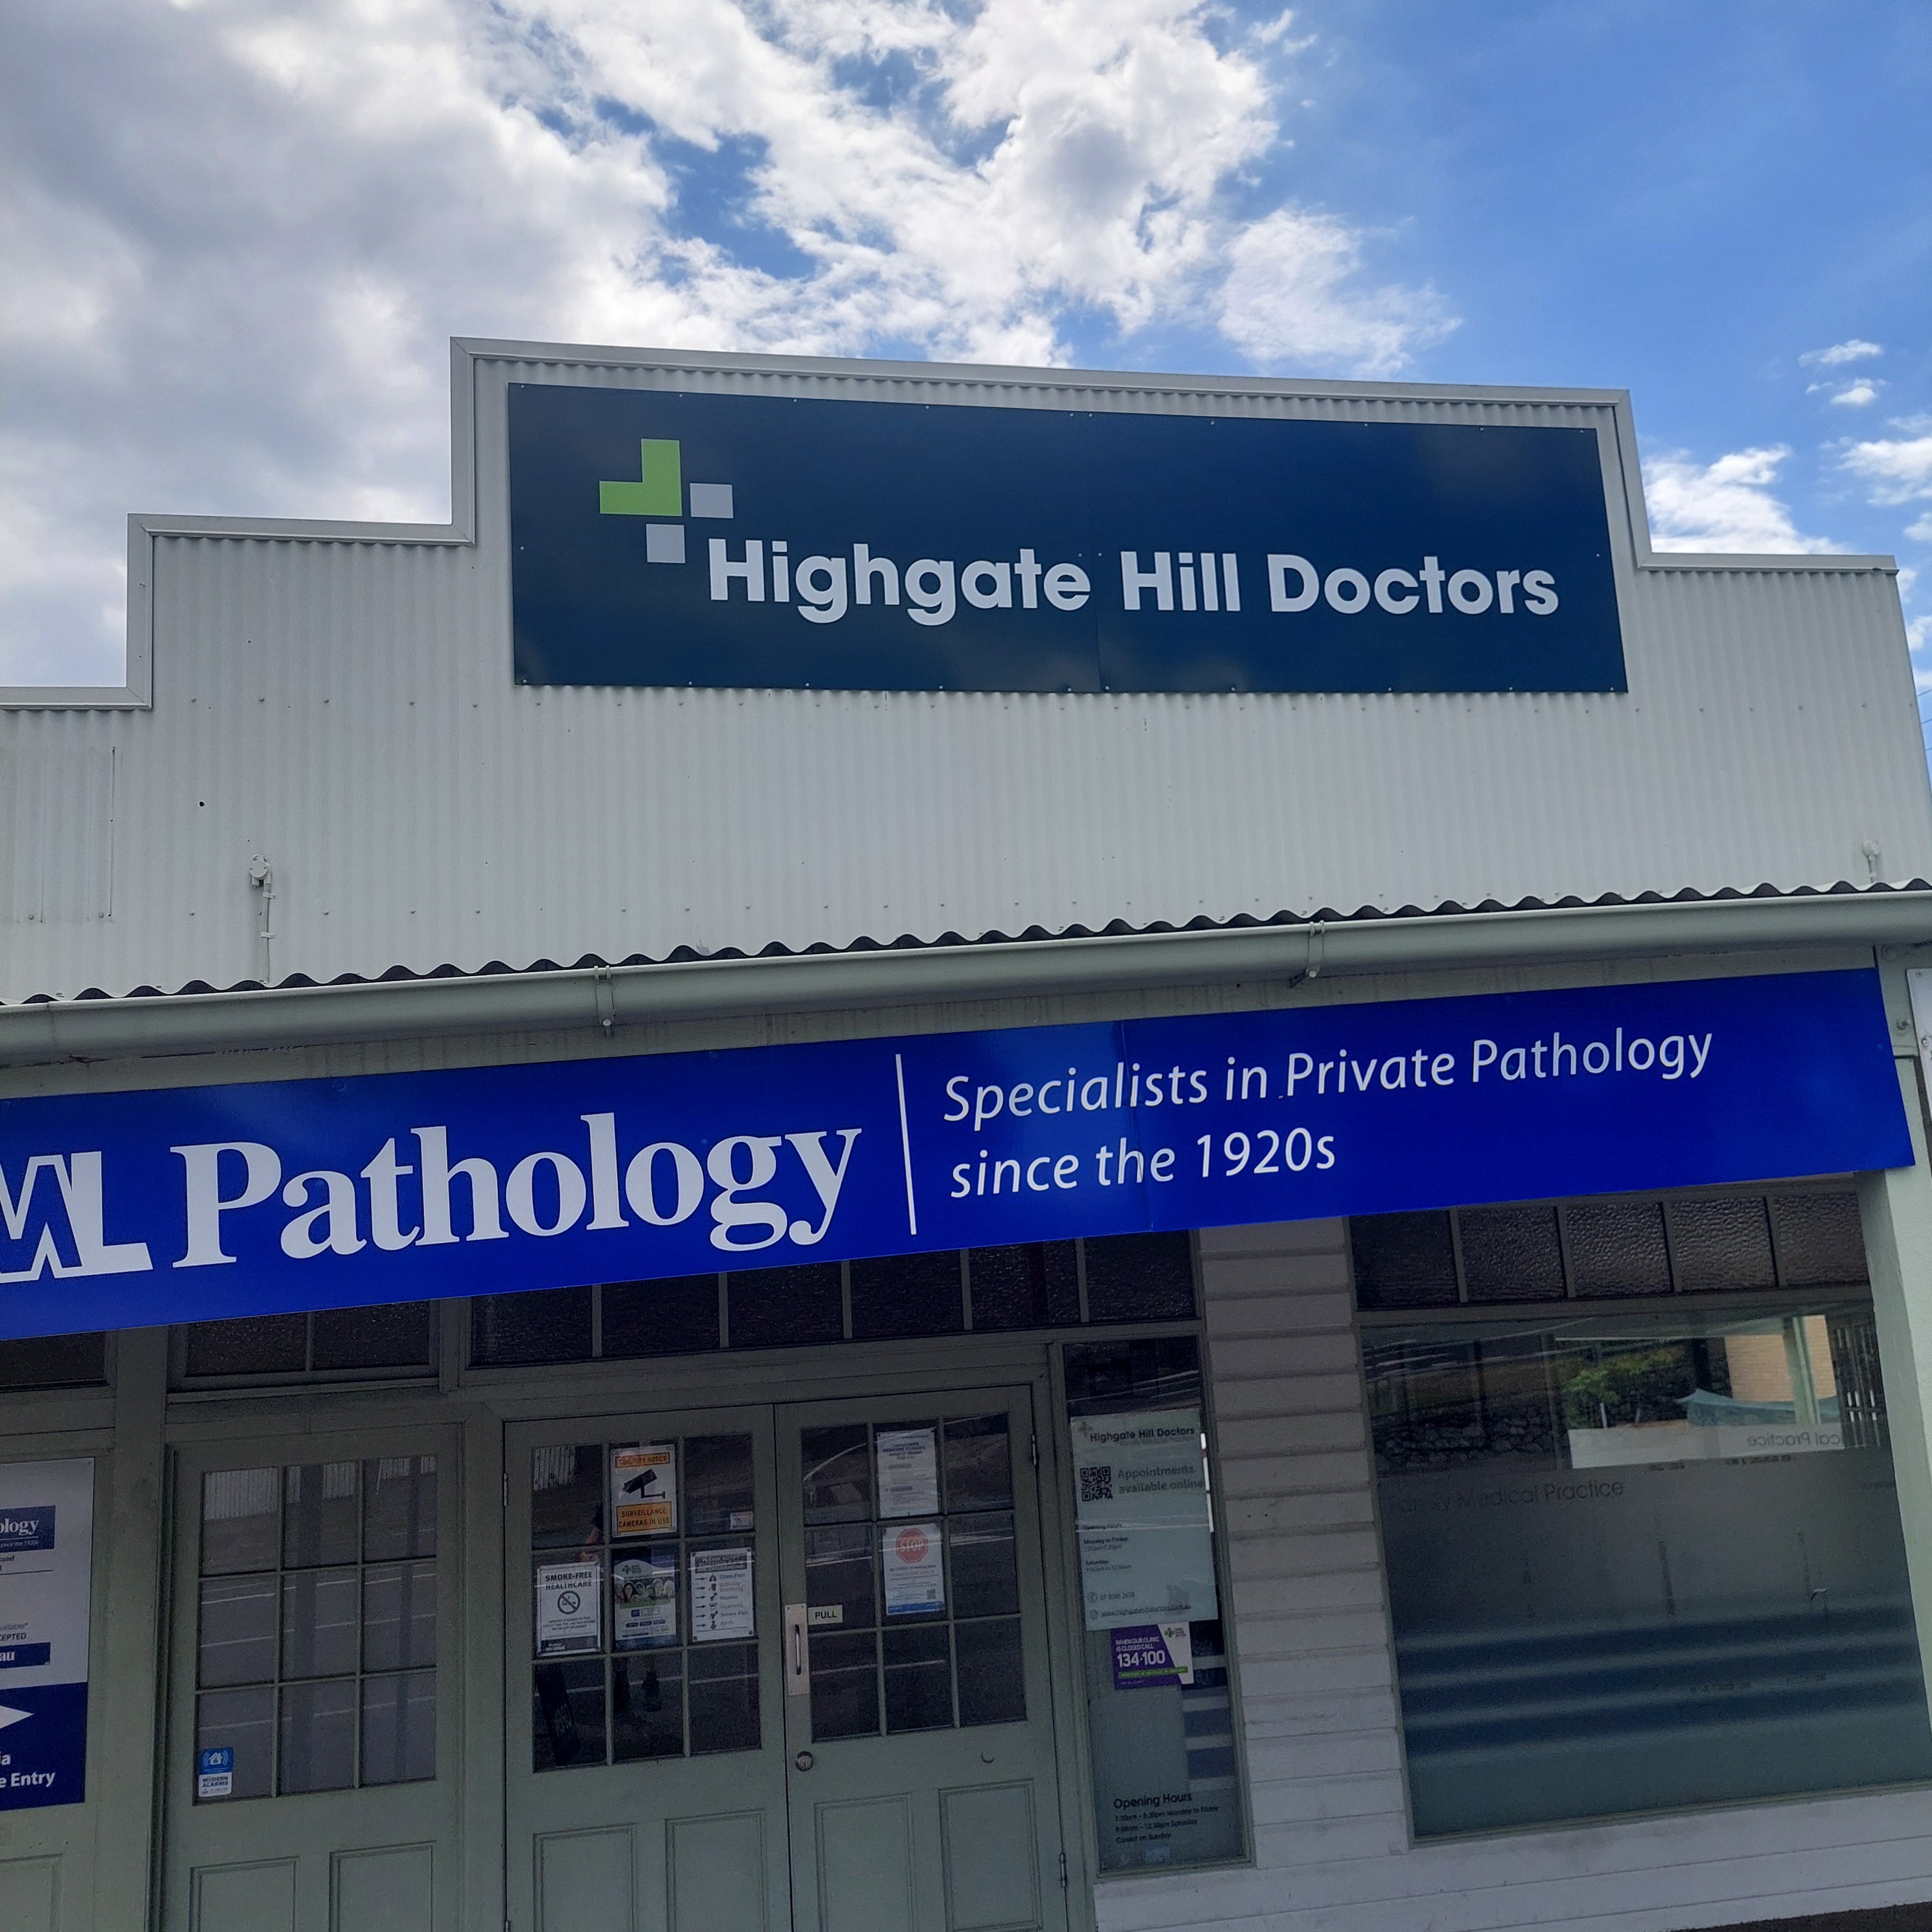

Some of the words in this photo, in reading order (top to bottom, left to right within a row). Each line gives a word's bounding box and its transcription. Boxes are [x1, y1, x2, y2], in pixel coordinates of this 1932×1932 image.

[708, 538, 1091, 626] Highgate
[1120, 551, 1241, 612] Hill
[1266, 554, 1559, 615] Doctors
[944, 1061, 1208, 1132] Specialists
[1225, 1056, 1268, 1101] in
[1287, 1048, 1455, 1097] Private
[1472, 1027, 1713, 1084] Pathology
[950, 1150, 1080, 1199] since
[1095, 1137, 1176, 1186] the
[1196, 1127, 1336, 1178] 1920s
[170, 1112, 862, 1269] Pathology
[1090, 1431, 1136, 1443] Highgate
[1138, 1428, 1155, 1438] Hill
[1156, 1426, 1196, 1437] Doctors
[1117, 1465, 1194, 1481] Appointments
[1118, 1480, 1168, 1494] available
[1169, 1478, 1205, 1490] online
[1544, 1477, 1625, 1503] Practice
[621, 1507, 667, 1518] SURVEILLANCE
[618, 1519, 648, 1528] CAMERAS
[899, 1539, 924, 1552] STOP
[545, 1571, 593, 1582] SMOKE-FREE
[545, 1580, 592, 1590] HEALTHCARE
[815, 1610, 837, 1620] PULL
[11, 1772, 56, 1788] Entry
[1113, 1795, 1160, 1811] Opening
[1162, 1793, 1192, 1804] Hours
